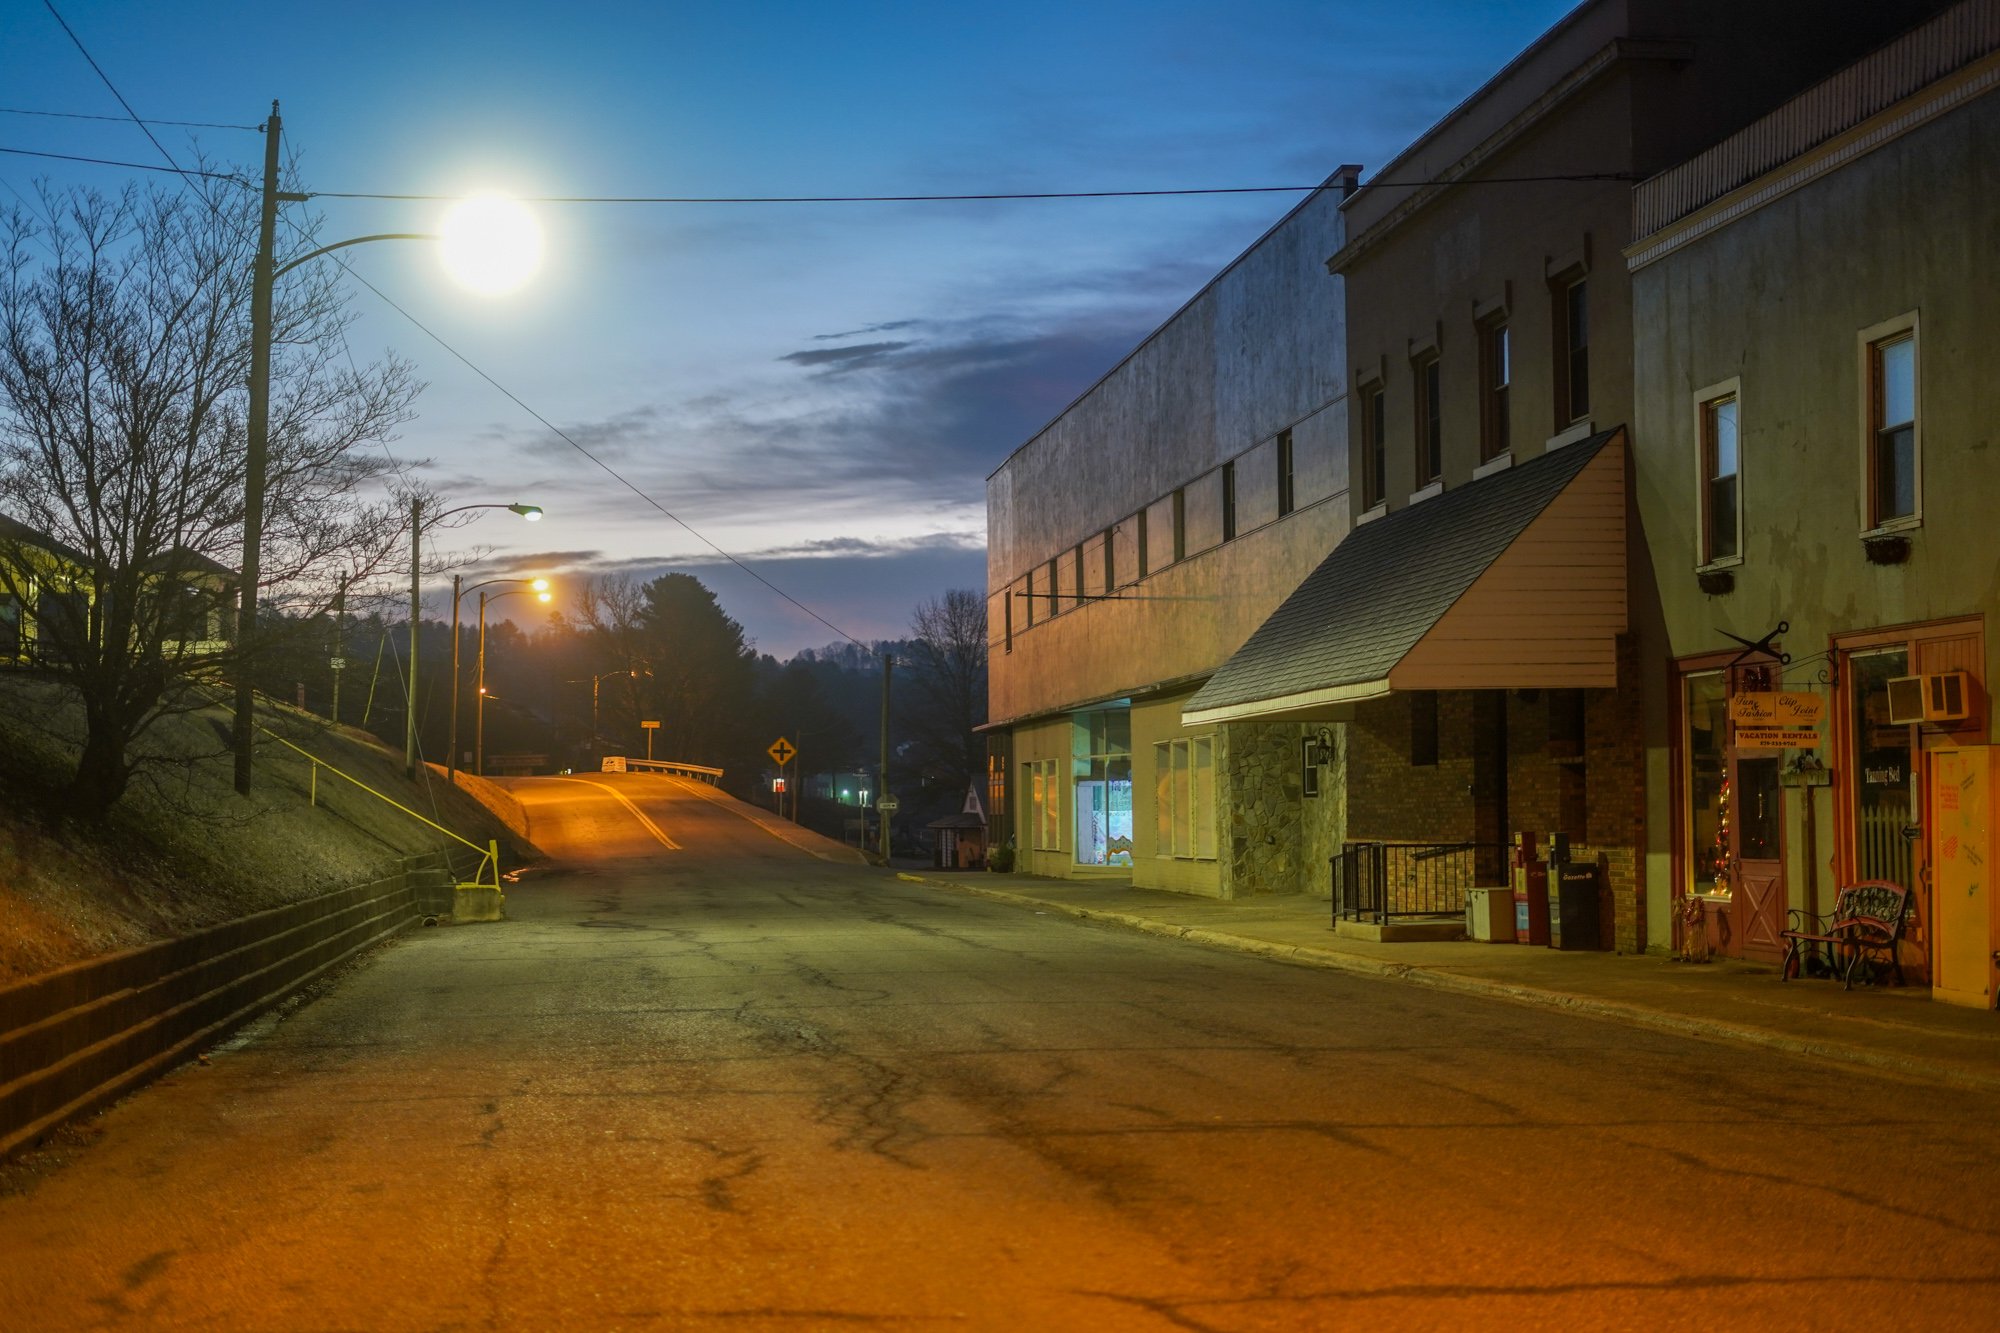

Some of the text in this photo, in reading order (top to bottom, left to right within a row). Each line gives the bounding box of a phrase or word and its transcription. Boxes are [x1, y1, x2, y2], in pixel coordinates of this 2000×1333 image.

[1779, 695, 1797, 707] Clip
[1737, 708, 1773, 717] Fashion
[1793, 704, 1819, 716] Joint
[1865, 766, 1900, 786] Tanning Bed
